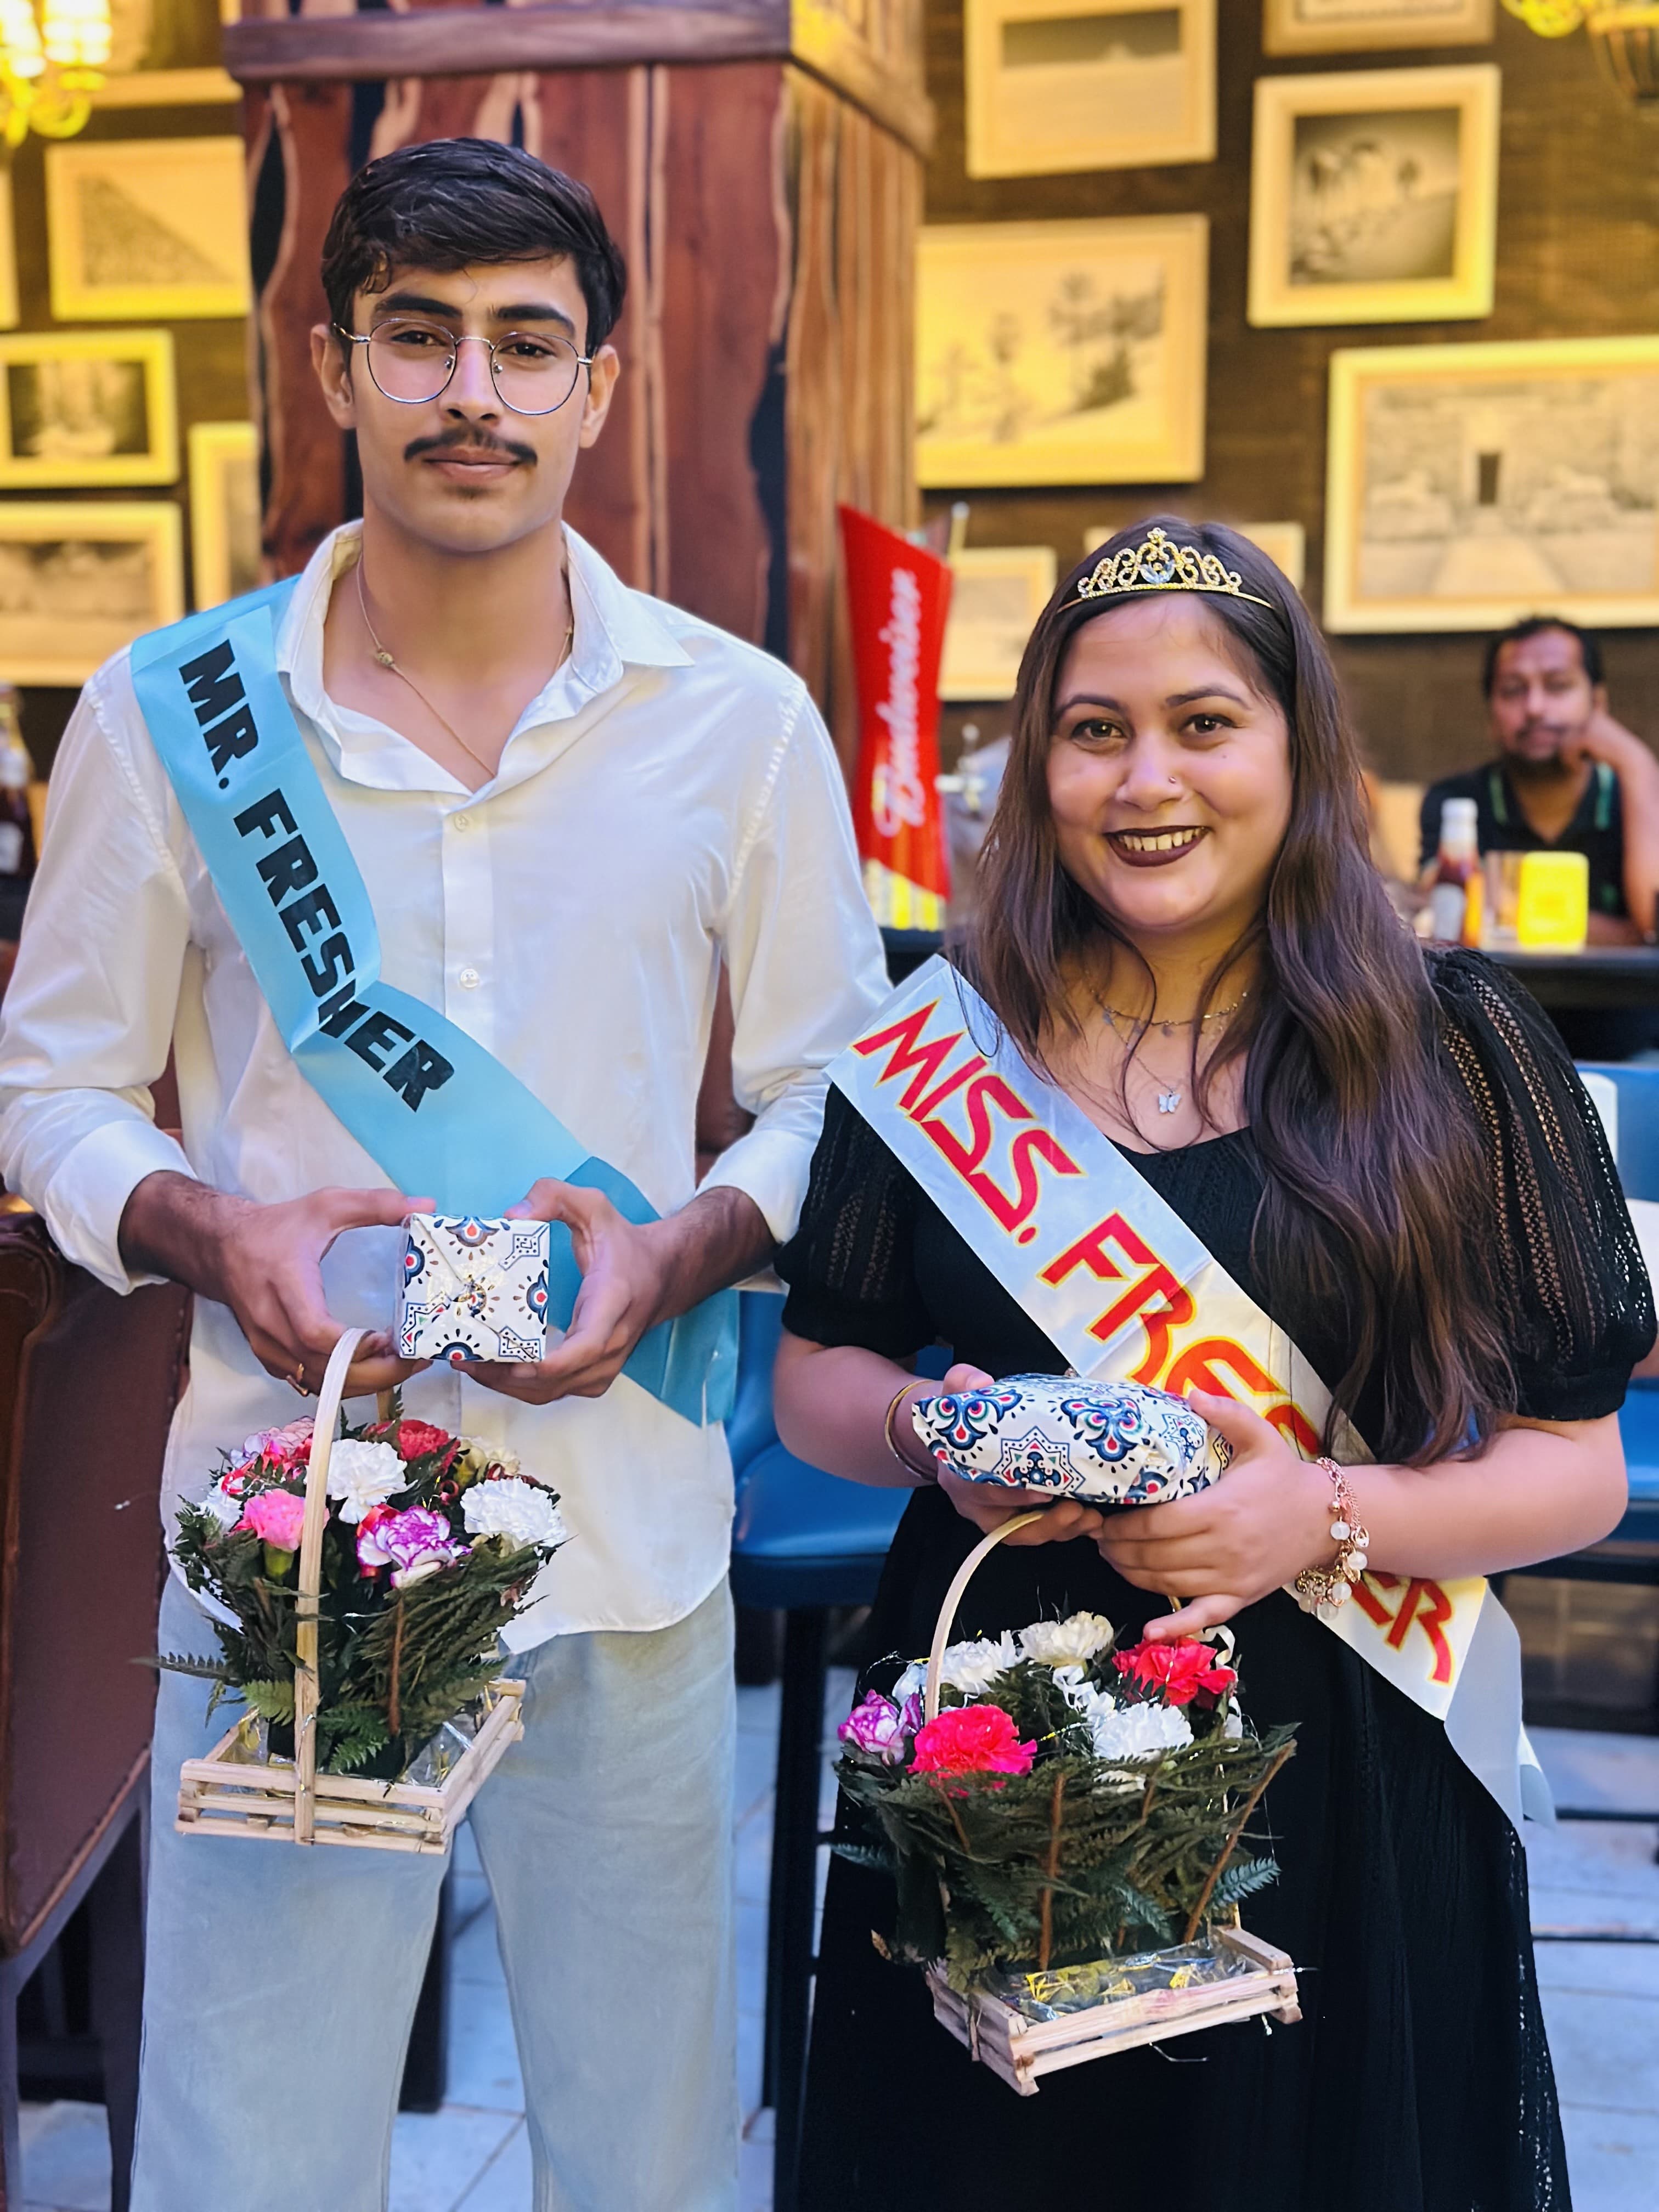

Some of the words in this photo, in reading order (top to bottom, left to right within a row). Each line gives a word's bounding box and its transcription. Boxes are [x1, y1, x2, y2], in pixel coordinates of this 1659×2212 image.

[179, 639, 259, 789] MR.
[233, 788, 455, 1112] FRESHER
[851, 996, 1087, 1248] MISS.
